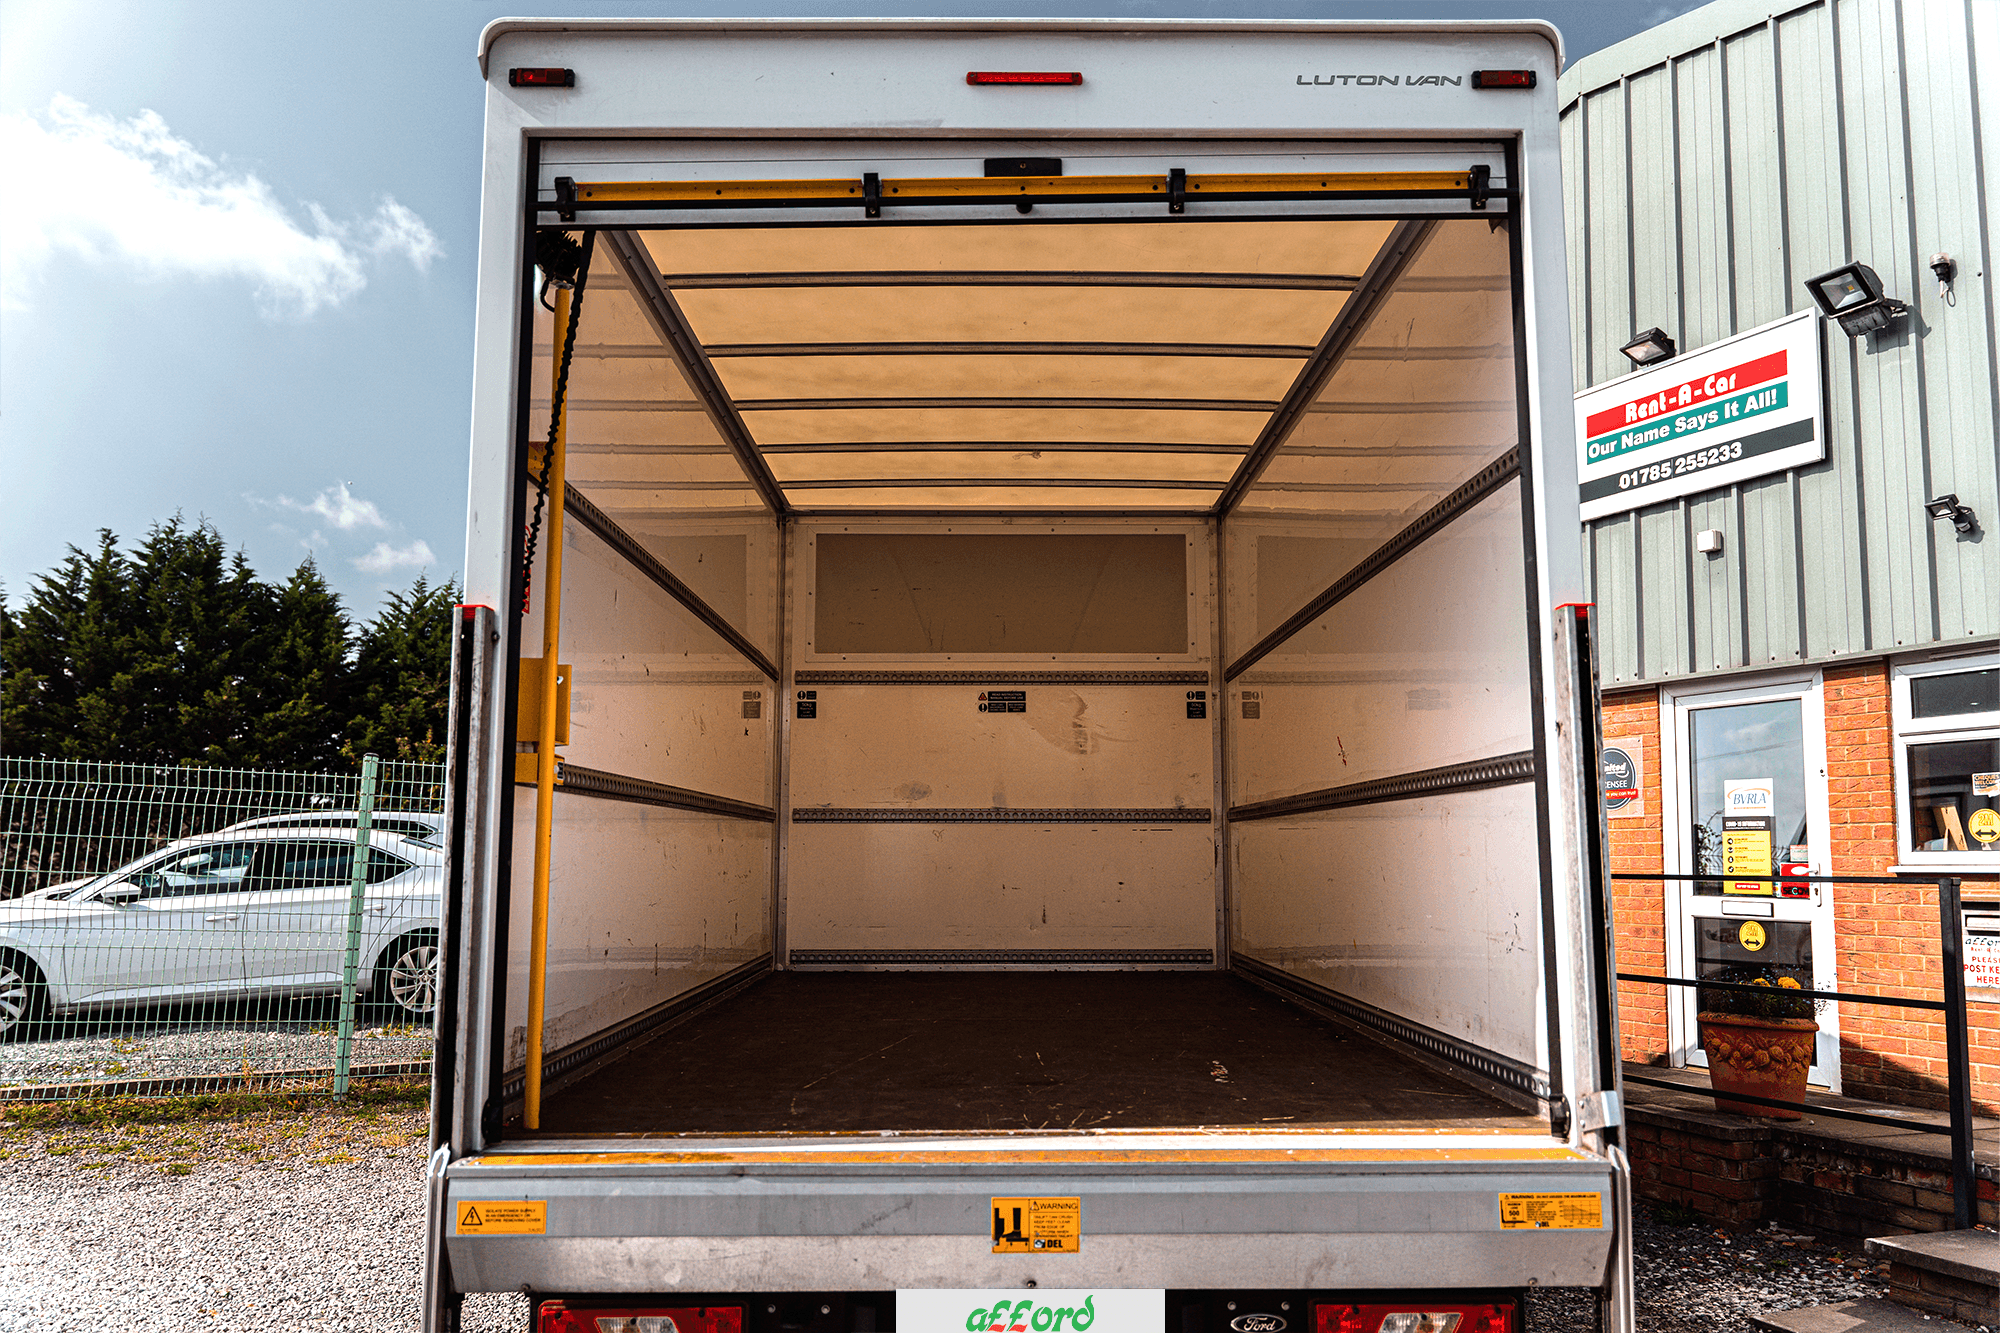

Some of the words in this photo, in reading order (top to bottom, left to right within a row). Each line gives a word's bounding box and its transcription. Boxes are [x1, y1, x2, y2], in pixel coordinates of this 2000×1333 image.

[1297, 75, 1399, 86] LUTON
[1406, 76, 1462, 86] VAN
[1625, 373, 1736, 423] Rent-A-Car
[1588, 440, 1617, 459] Our
[1621, 424, 1670, 450] Name
[1675, 409, 1718, 431] Says
[1724, 401, 1740, 419] It
[1744, 389, 1777, 414] All!
[1619, 459, 1672, 489] 01785
[1674, 442, 1743, 474] 255233
[1604, 762, 1627, 773] nited
[1734, 793, 1767, 805] BVRLA
[1965, 937, 2000, 946] affor
[1964, 964, 1986, 973] POST
[1977, 976, 2000, 984] HERE
[1047, 1240, 1063, 1248] DEL
[1243, 1316, 1276, 1331] Ford
